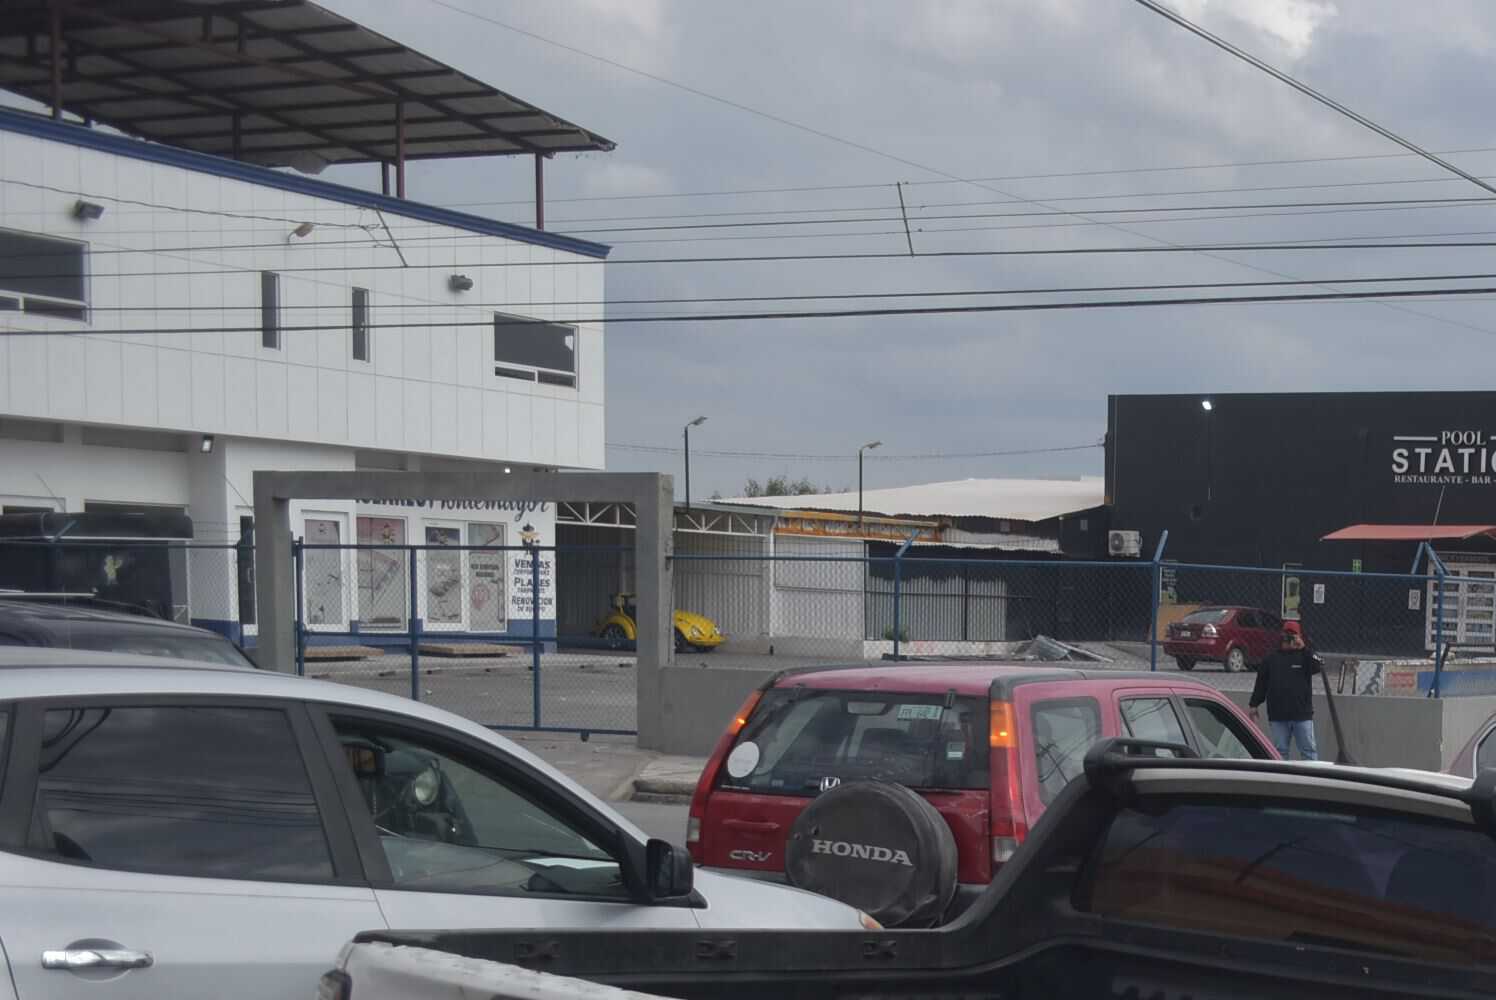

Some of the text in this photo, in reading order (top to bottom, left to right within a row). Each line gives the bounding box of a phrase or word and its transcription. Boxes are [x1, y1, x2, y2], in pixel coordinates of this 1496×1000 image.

[1441, 430, 1486, 446] POOL
[1394, 474, 1463, 484] RESTAURANTE
[1471, 475, 1491, 485] BAR
[514, 559, 551, 569] VENAS
[513, 577, 551, 587] PLAES
[729, 849, 773, 862] CR-V
[812, 839, 913, 866] HONDA
